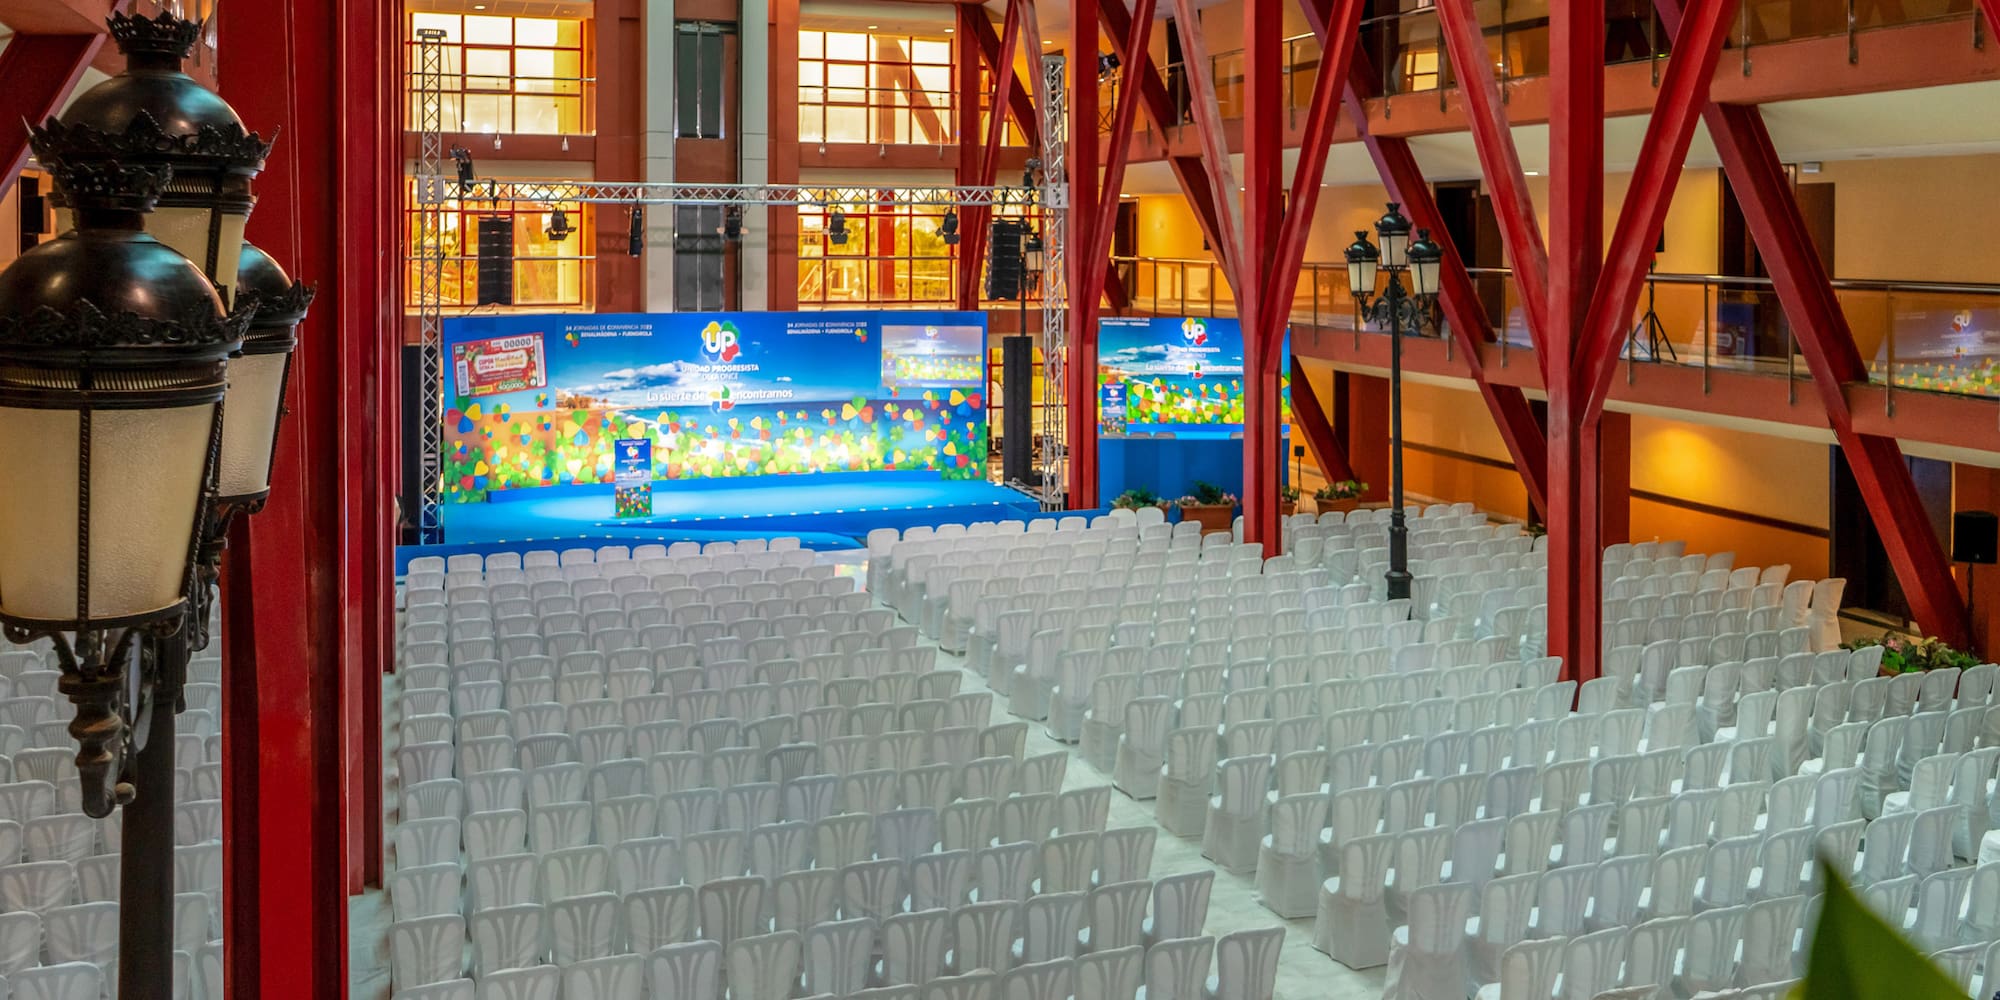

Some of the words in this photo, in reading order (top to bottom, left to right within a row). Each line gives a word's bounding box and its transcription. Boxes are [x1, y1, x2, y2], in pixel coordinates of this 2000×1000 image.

[1184, 323, 1206, 339] UP
[504, 338, 531, 349] 00000
[706, 331, 736, 353] UP
[682, 366, 711, 374] UNIDAD
[711, 364, 760, 373] PROGRESISTA
[647, 391, 659, 402] La
[660, 391, 691, 401] suerte
[691, 389, 706, 401] de
[730, 387, 793, 400] encontrarnos
